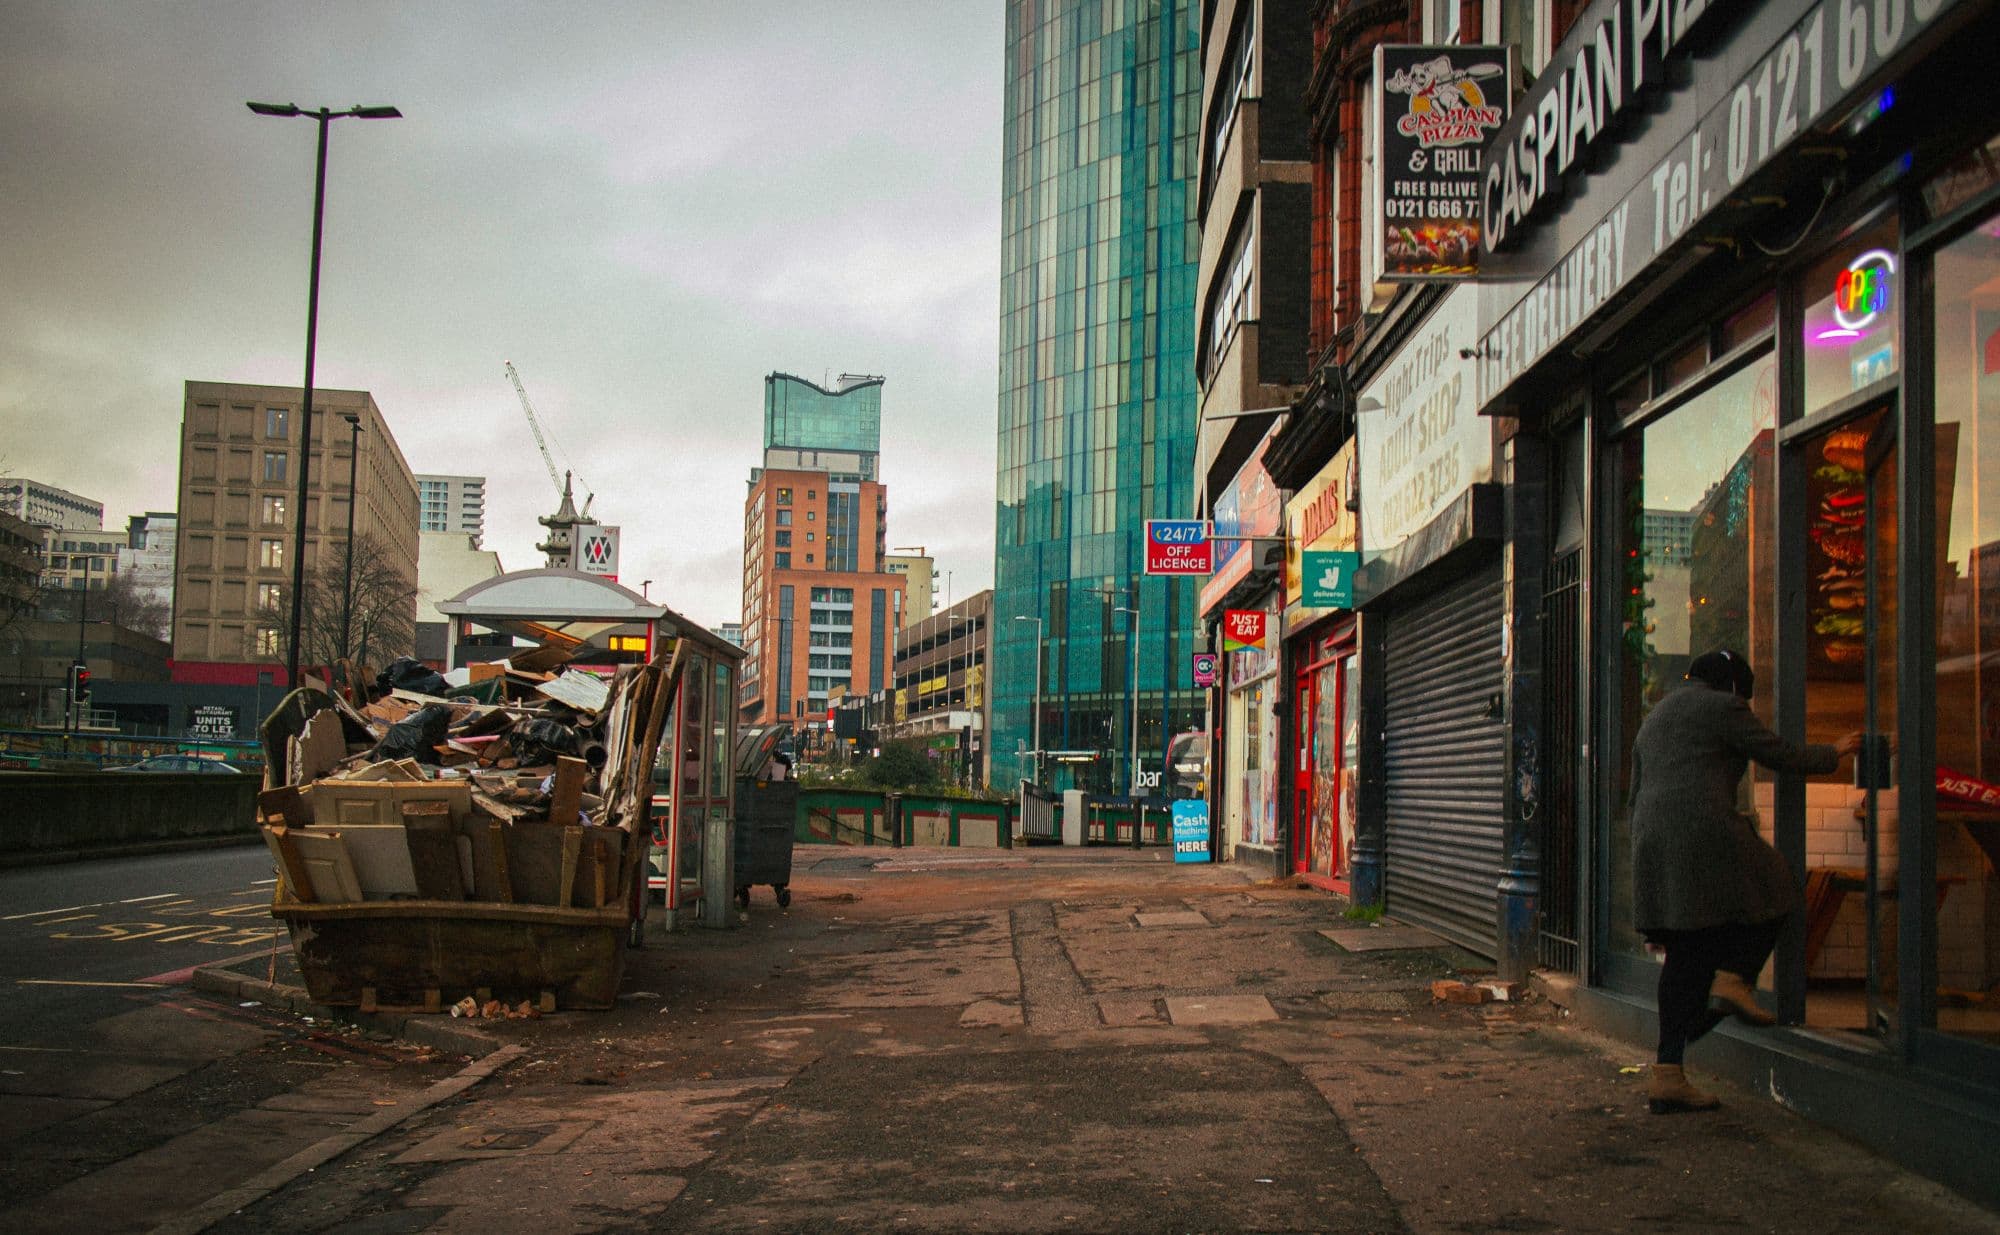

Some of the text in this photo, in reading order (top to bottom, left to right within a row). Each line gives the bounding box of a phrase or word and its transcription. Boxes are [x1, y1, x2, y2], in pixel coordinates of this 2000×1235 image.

[1401, 107, 1496, 132] CASPIAN
[1484, 0, 1621, 254] CASPIAN
[1422, 123, 1479, 144] PIZZA
[1408, 150, 1428, 172] &
[1395, 181, 1427, 196] FREE
[1386, 199, 1424, 218] 0121
[1427, 199, 1462, 218] 666
[1481, 308, 1520, 405] FREE
[1525, 200, 1629, 367] DELIVERY
[1652, 130, 1709, 254] Tel:
[1727, 7, 1824, 187] 0121
[1415, 324, 1449, 388] Trips
[1380, 371, 1462, 488] ADULT SHOP
[1163, 526, 1197, 541] 24/7
[1166, 545, 1192, 557] OFF
[1152, 557, 1207, 569] LICENCE
[1231, 613, 1260, 627] JUST
[1236, 624, 1260, 636] EAT
[196, 716, 231, 725] UNITS
[194, 725, 233, 733] TO LET
[1137, 758, 1162, 788] bar
[1173, 814, 1208, 827] Cash
[1176, 841, 1208, 852] HERE
